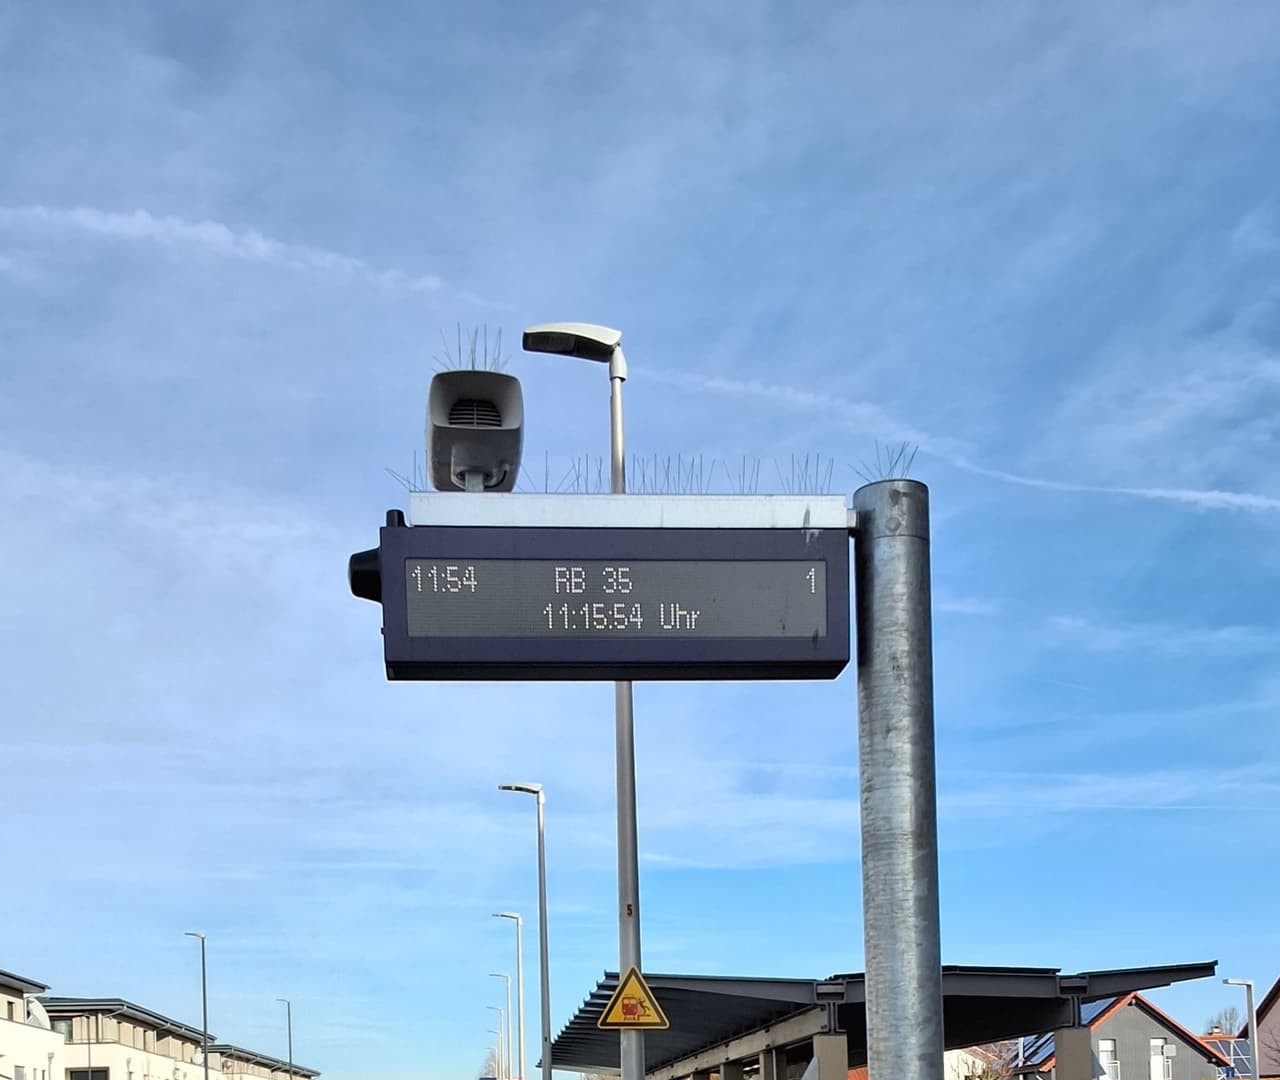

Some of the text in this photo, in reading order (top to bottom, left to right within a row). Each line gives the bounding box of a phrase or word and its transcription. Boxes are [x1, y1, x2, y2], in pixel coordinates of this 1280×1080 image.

[411, 565, 816, 594] 11:54 RB 35 1
[543, 602, 701, 630] 11:15:54 Uhr
[626, 903, 633, 917] 5
